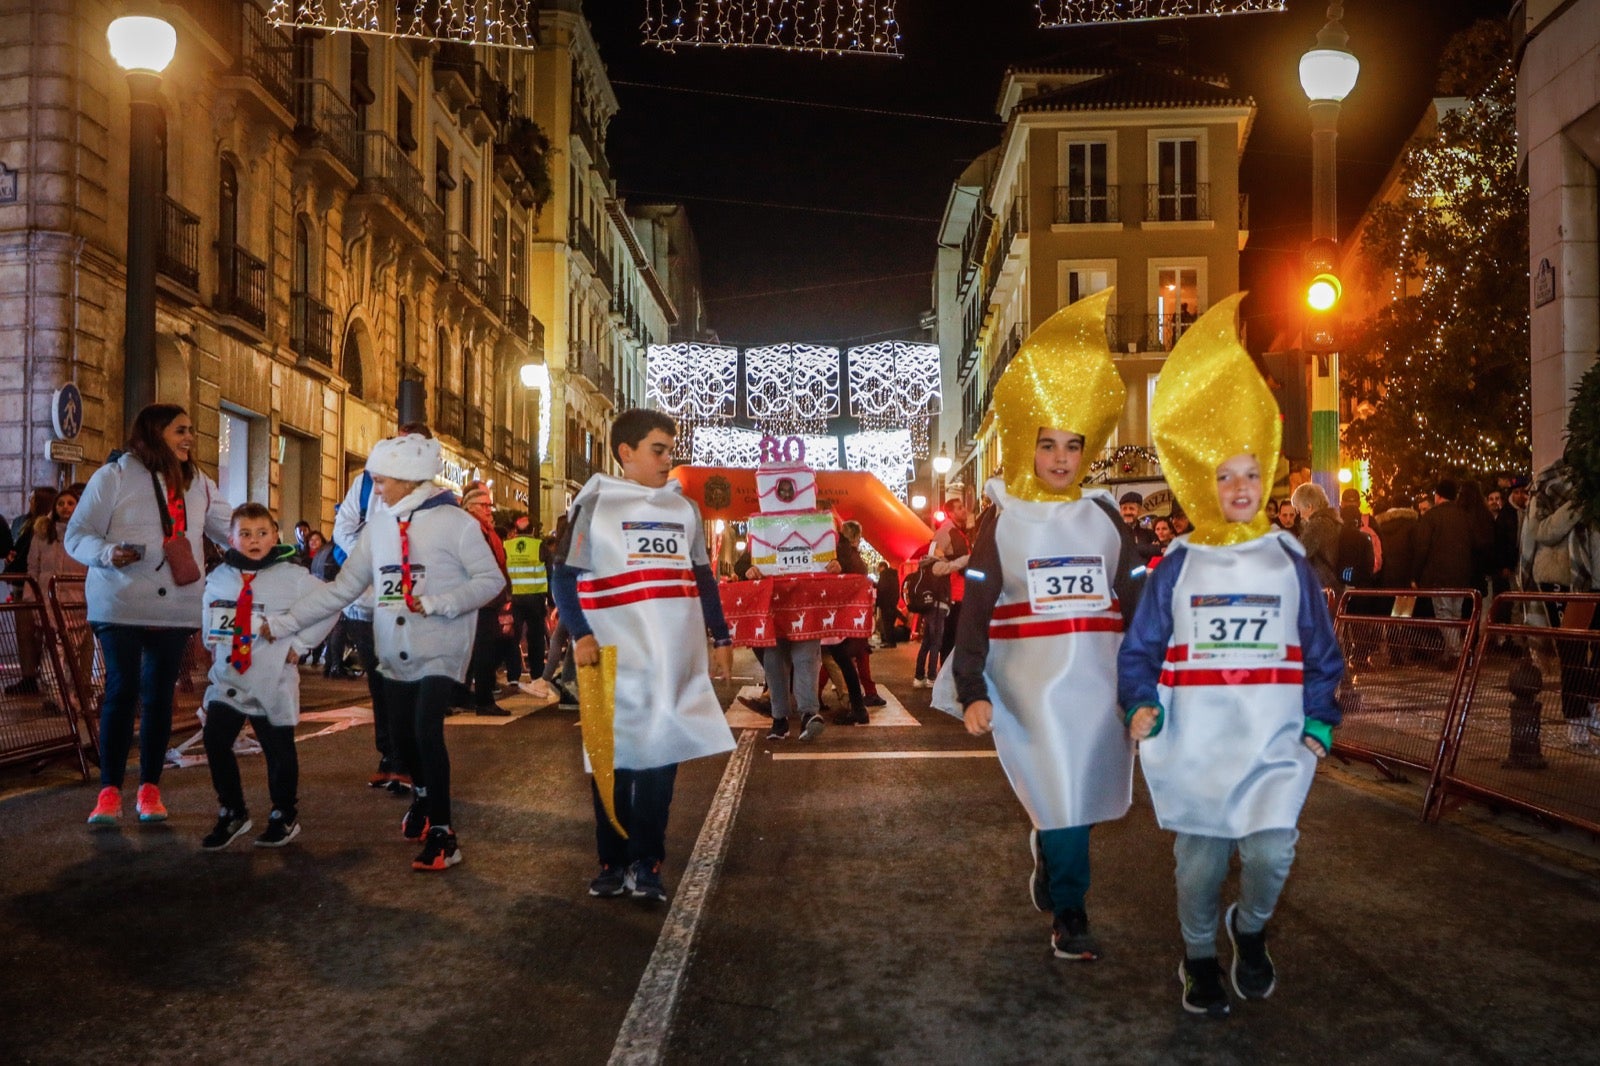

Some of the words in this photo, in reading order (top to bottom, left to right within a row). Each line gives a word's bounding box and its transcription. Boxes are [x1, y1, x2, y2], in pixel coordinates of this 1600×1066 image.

[638, 537, 678, 554] 260
[782, 555, 809, 565] 1116
[1046, 575, 1094, 595] 378
[220, 615, 237, 630] 24
[1209, 618, 1267, 641] 377
